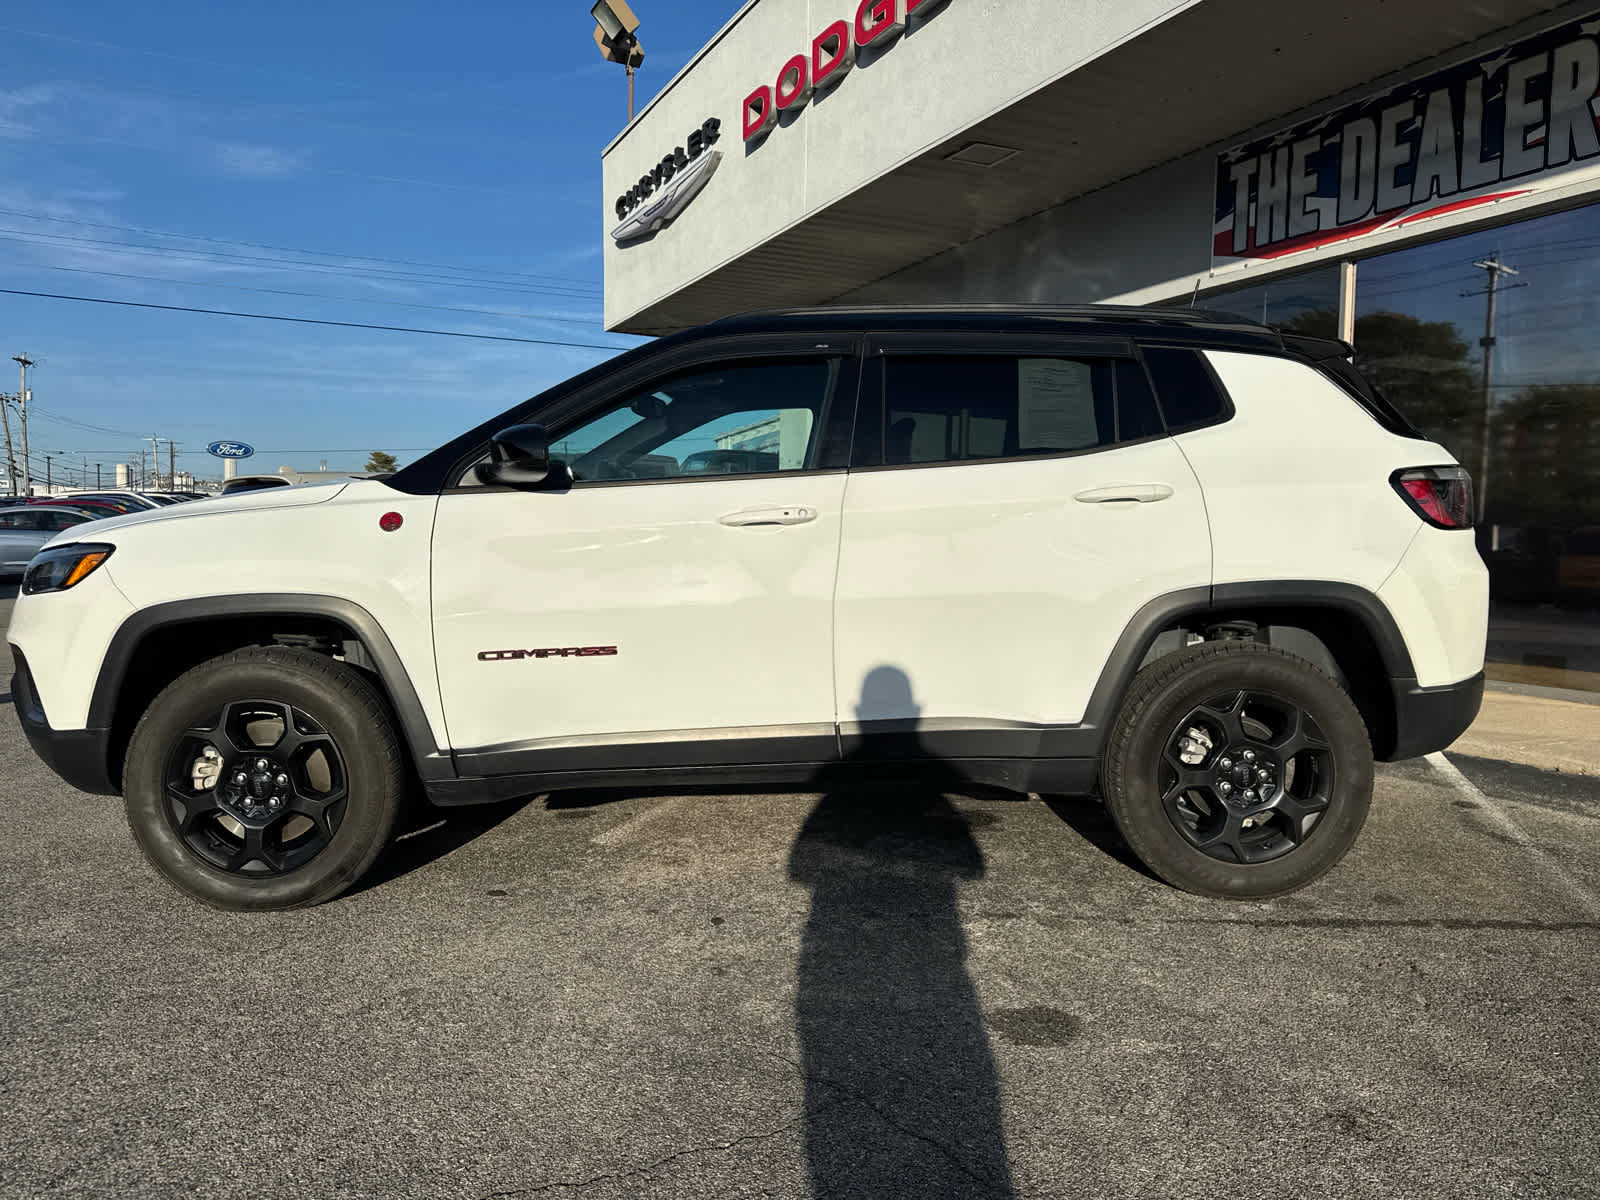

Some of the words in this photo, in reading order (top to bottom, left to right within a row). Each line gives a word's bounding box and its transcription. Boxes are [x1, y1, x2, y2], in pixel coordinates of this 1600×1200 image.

[743, 0, 930, 142] DODG
[1230, 133, 1322, 254] THE
[216, 443, 246, 455] Ford
[477, 645, 618, 661] COMPASS
